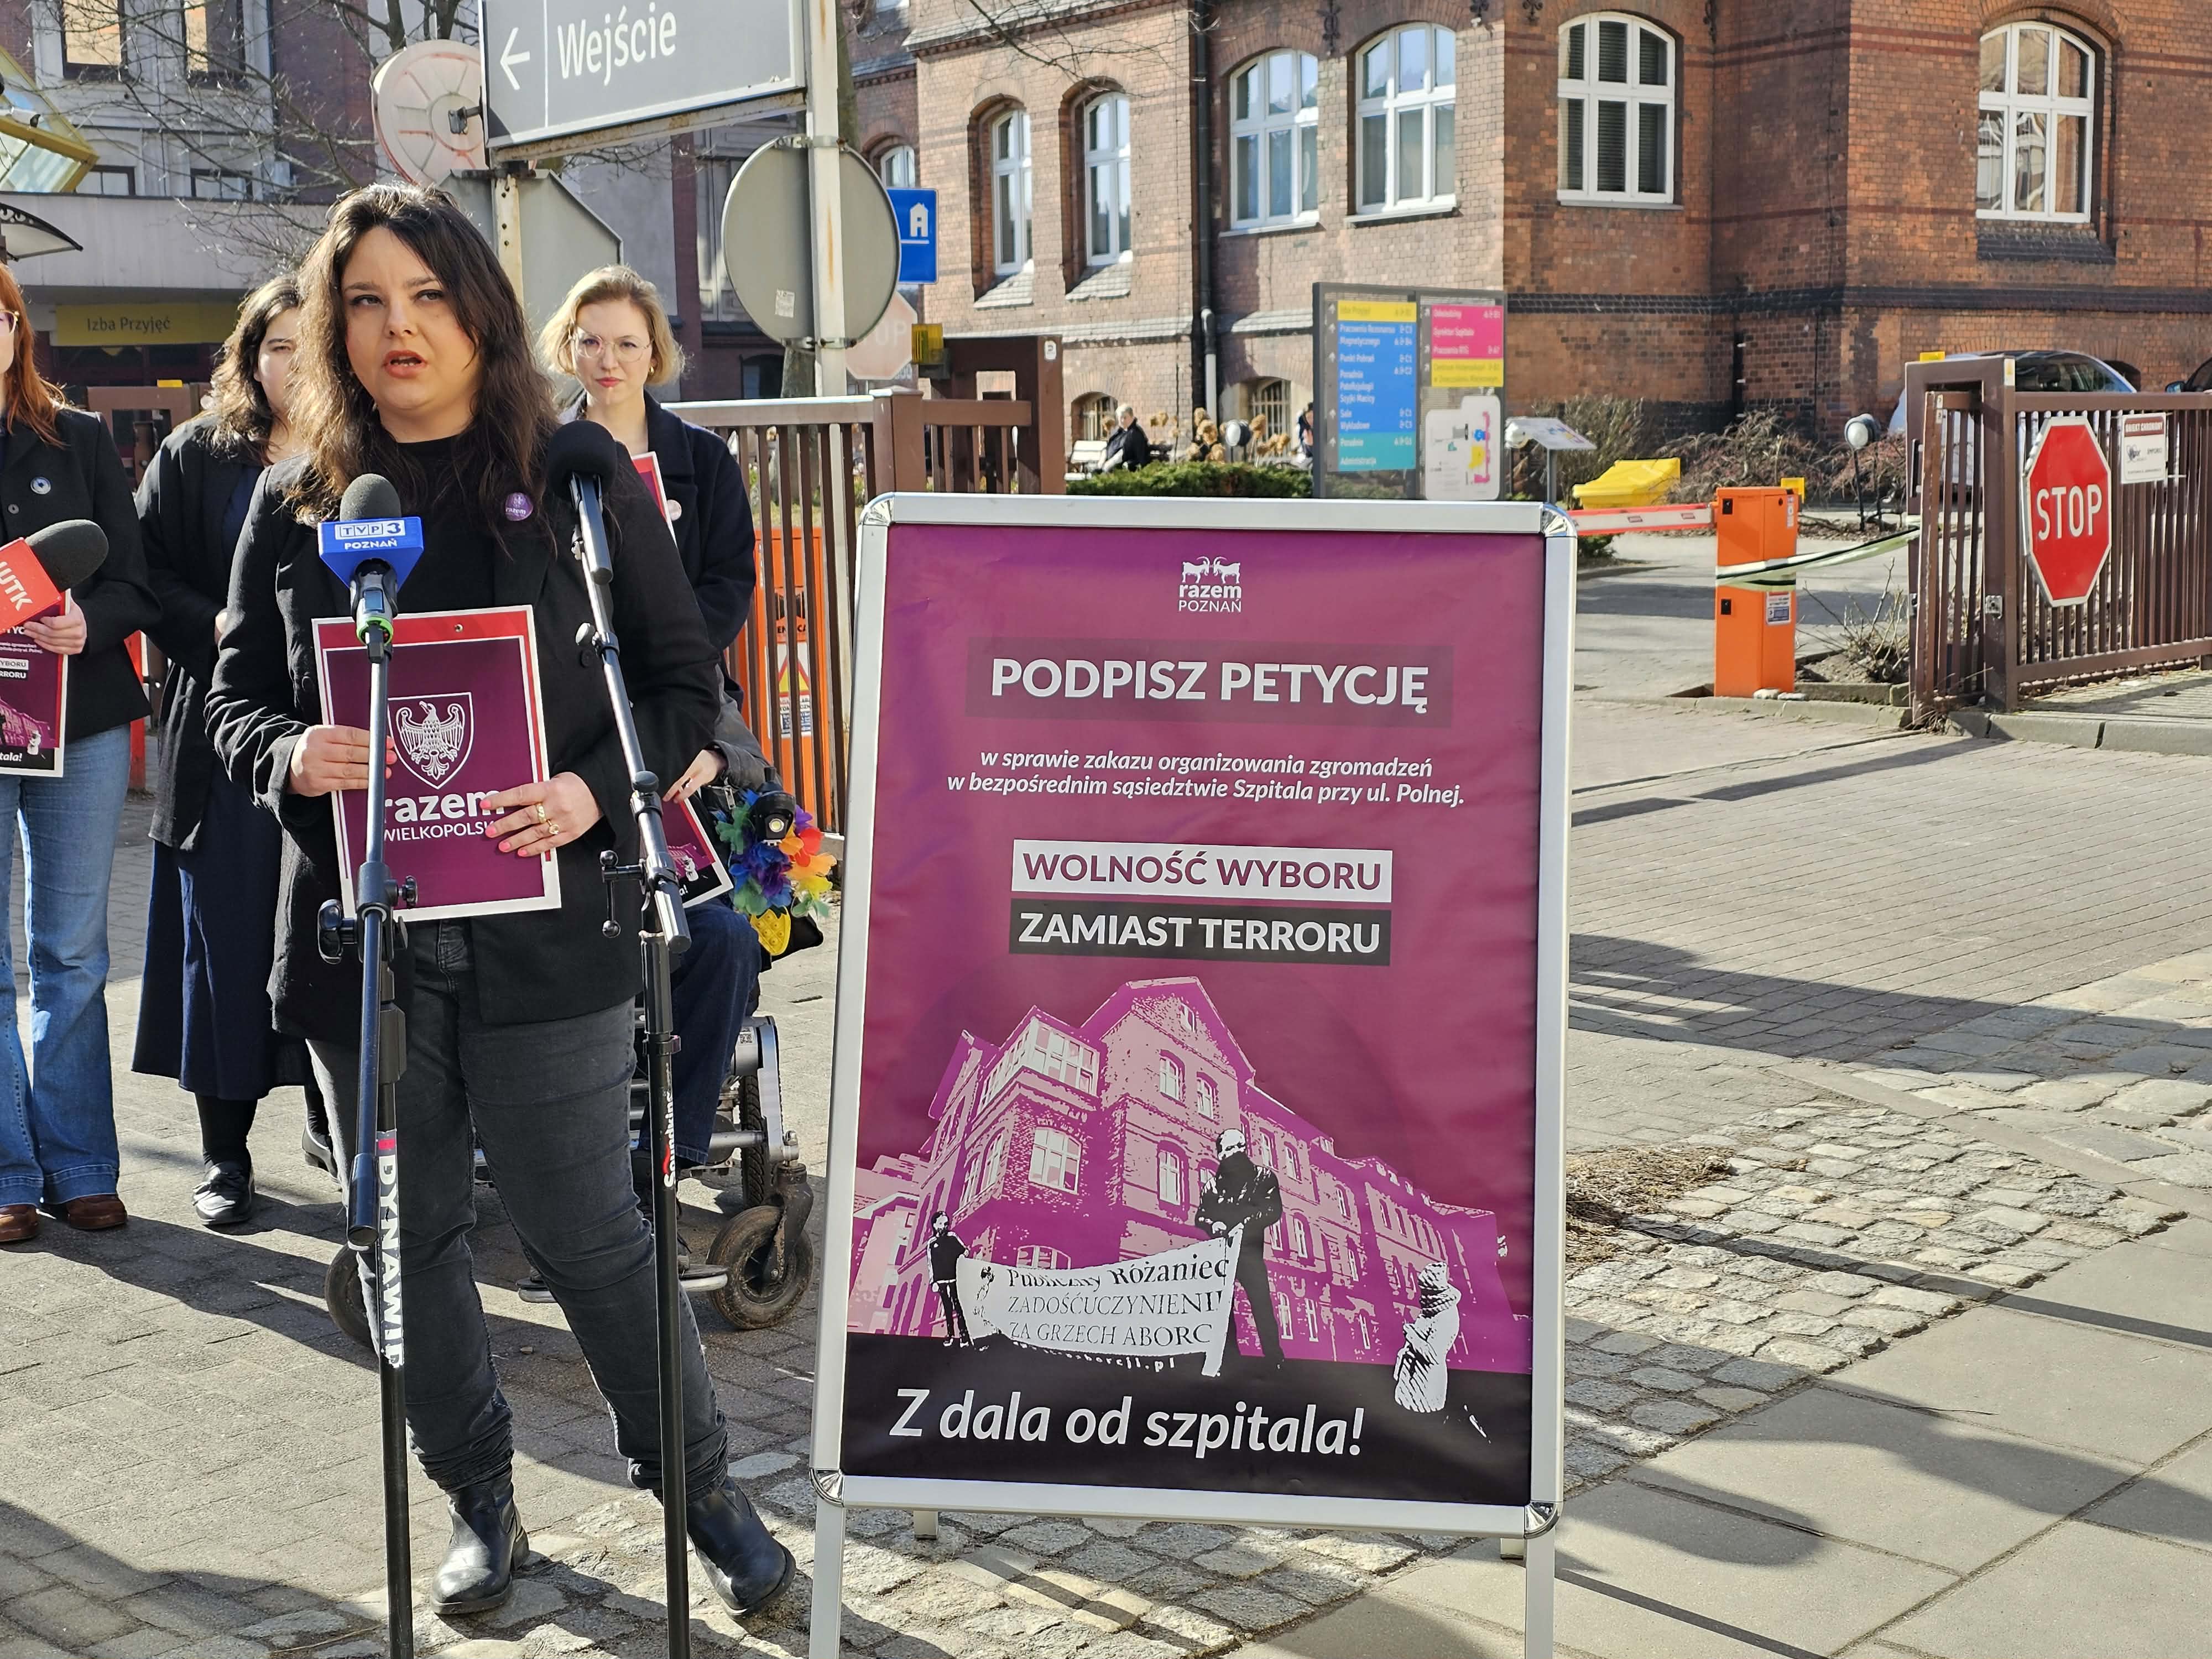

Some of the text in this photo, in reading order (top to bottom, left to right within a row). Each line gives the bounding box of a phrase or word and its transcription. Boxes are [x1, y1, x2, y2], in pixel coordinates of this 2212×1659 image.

[557, 1, 677, 86] Wejście
[87, 316, 171, 333] Izba Przyjęć
[2036, 484, 2103, 541] STOP
[343, 538, 398, 550] POZNAŃ
[1178, 599, 1241, 613] POZNAŃ
[1179, 584, 1241, 598] razem
[0, 670, 27, 679] RRORU
[992, 658, 1428, 714] PODPISZ PETYCJĘ
[0, 752, 23, 763] tala!
[981, 749, 1432, 779] w sprawie zakazu organizowania zgromadzeń
[948, 772, 1464, 807] w bezpośrednim sąsiedztwie Szpitala przy ul. Polnej.
[1022, 850, 1381, 891] WOLNOŚĆ WYBORU
[1018, 912, 1380, 954] ZAMIAST TERRORU
[1010, 1322, 1031, 1339] ZA
[1037, 1323, 1117, 1345] GRZECH
[889, 1389, 1364, 1459] Z dala od szpitala!
